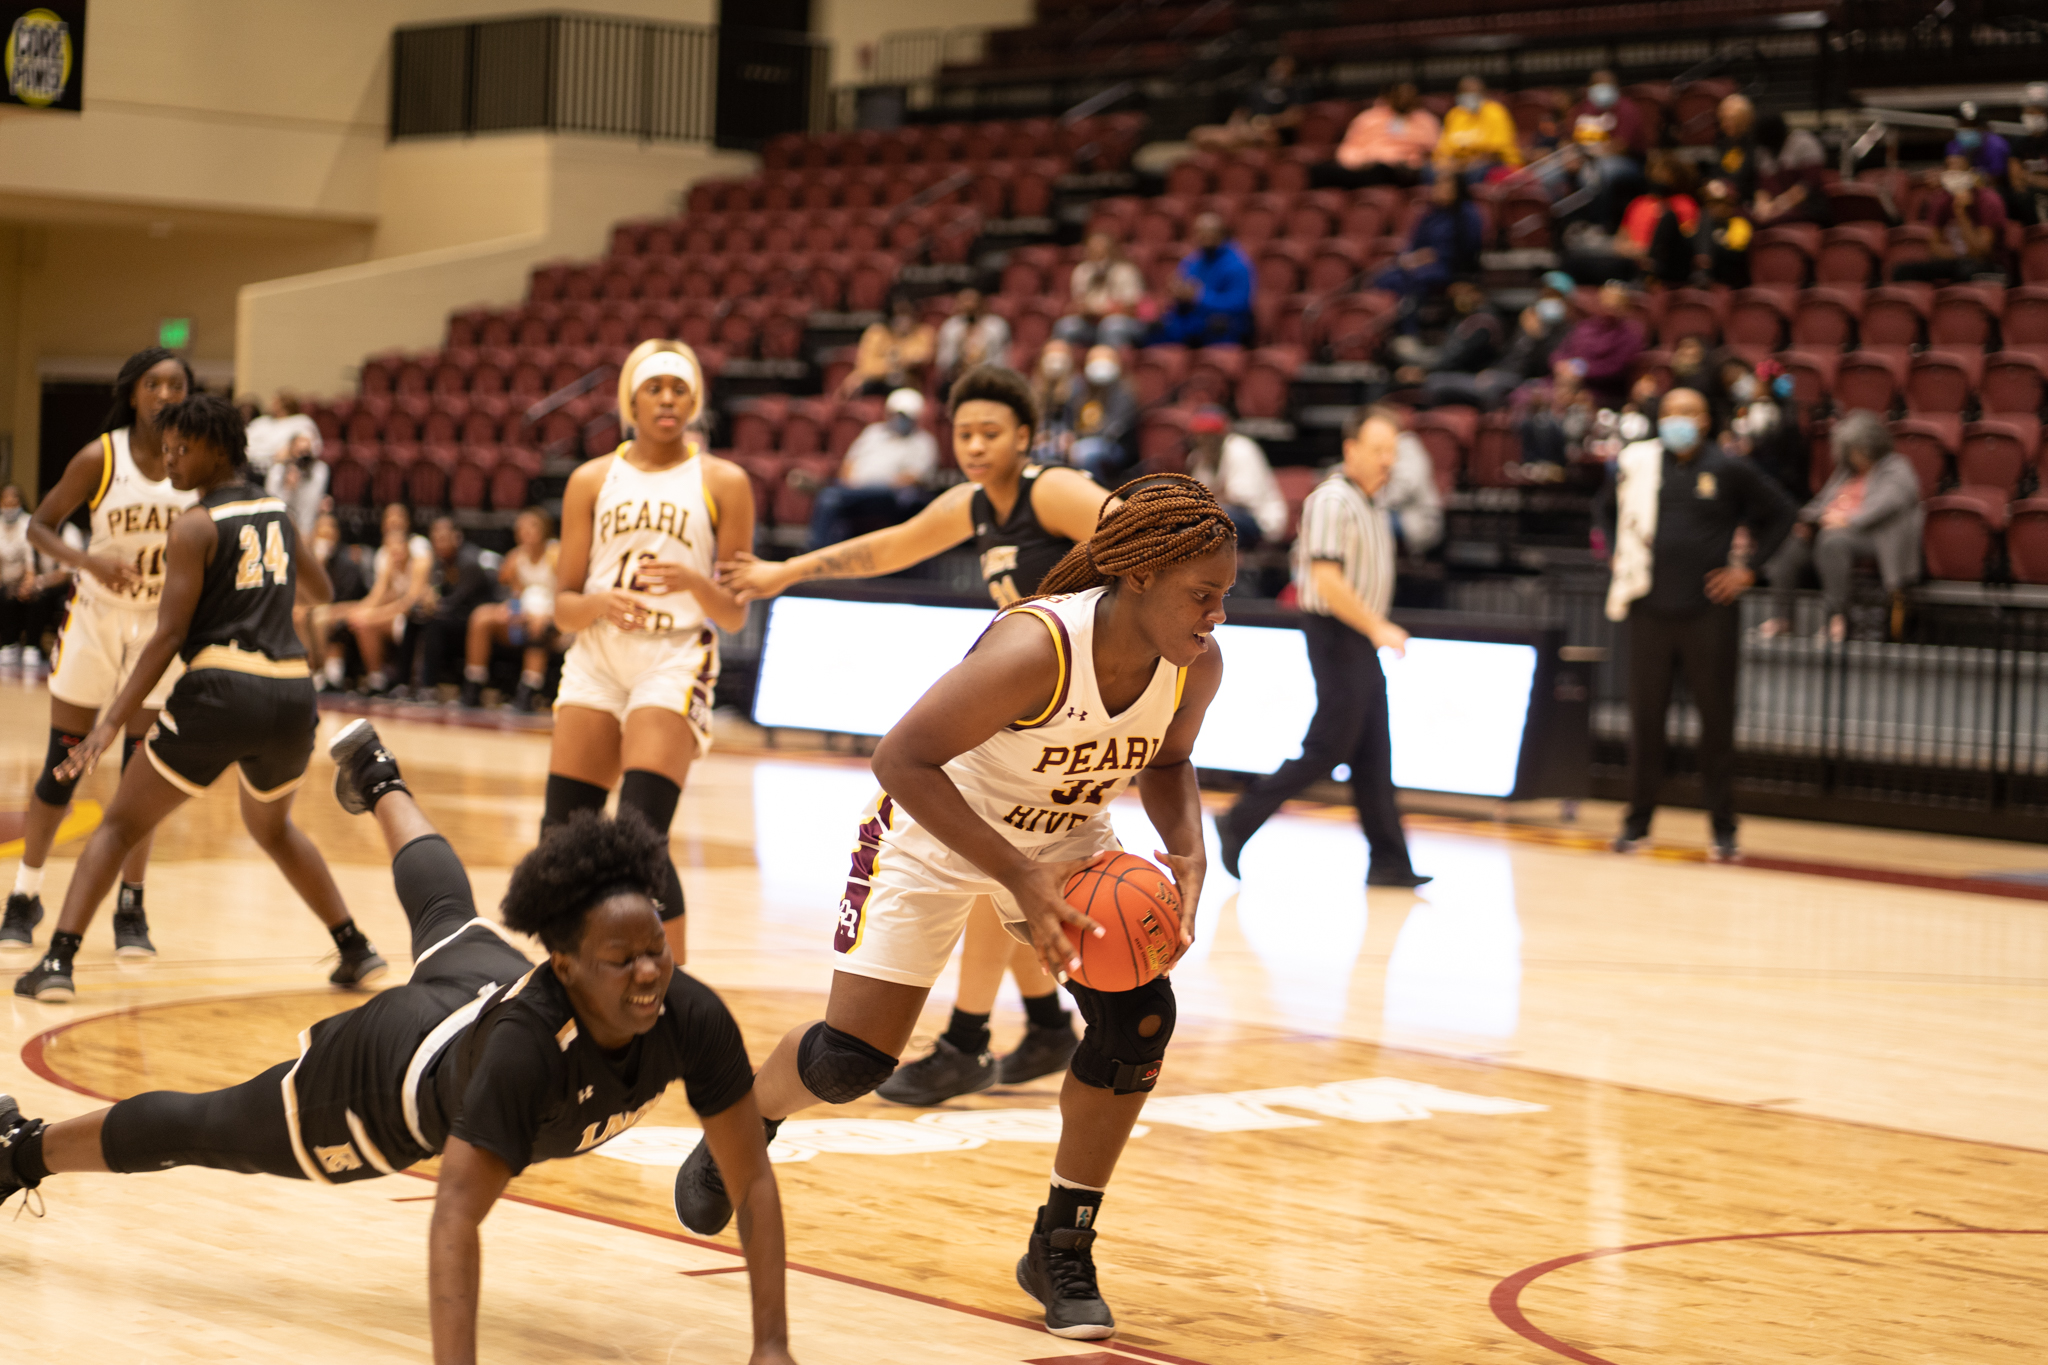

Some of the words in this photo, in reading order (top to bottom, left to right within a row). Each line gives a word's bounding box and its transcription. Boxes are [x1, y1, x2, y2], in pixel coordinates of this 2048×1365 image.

[107, 503, 183, 536] PEAR
[599, 500, 693, 550] PEARL
[235, 520, 290, 591] 24
[1051, 777, 1120, 805] 31
[1141, 909, 1170, 966] TF-10
